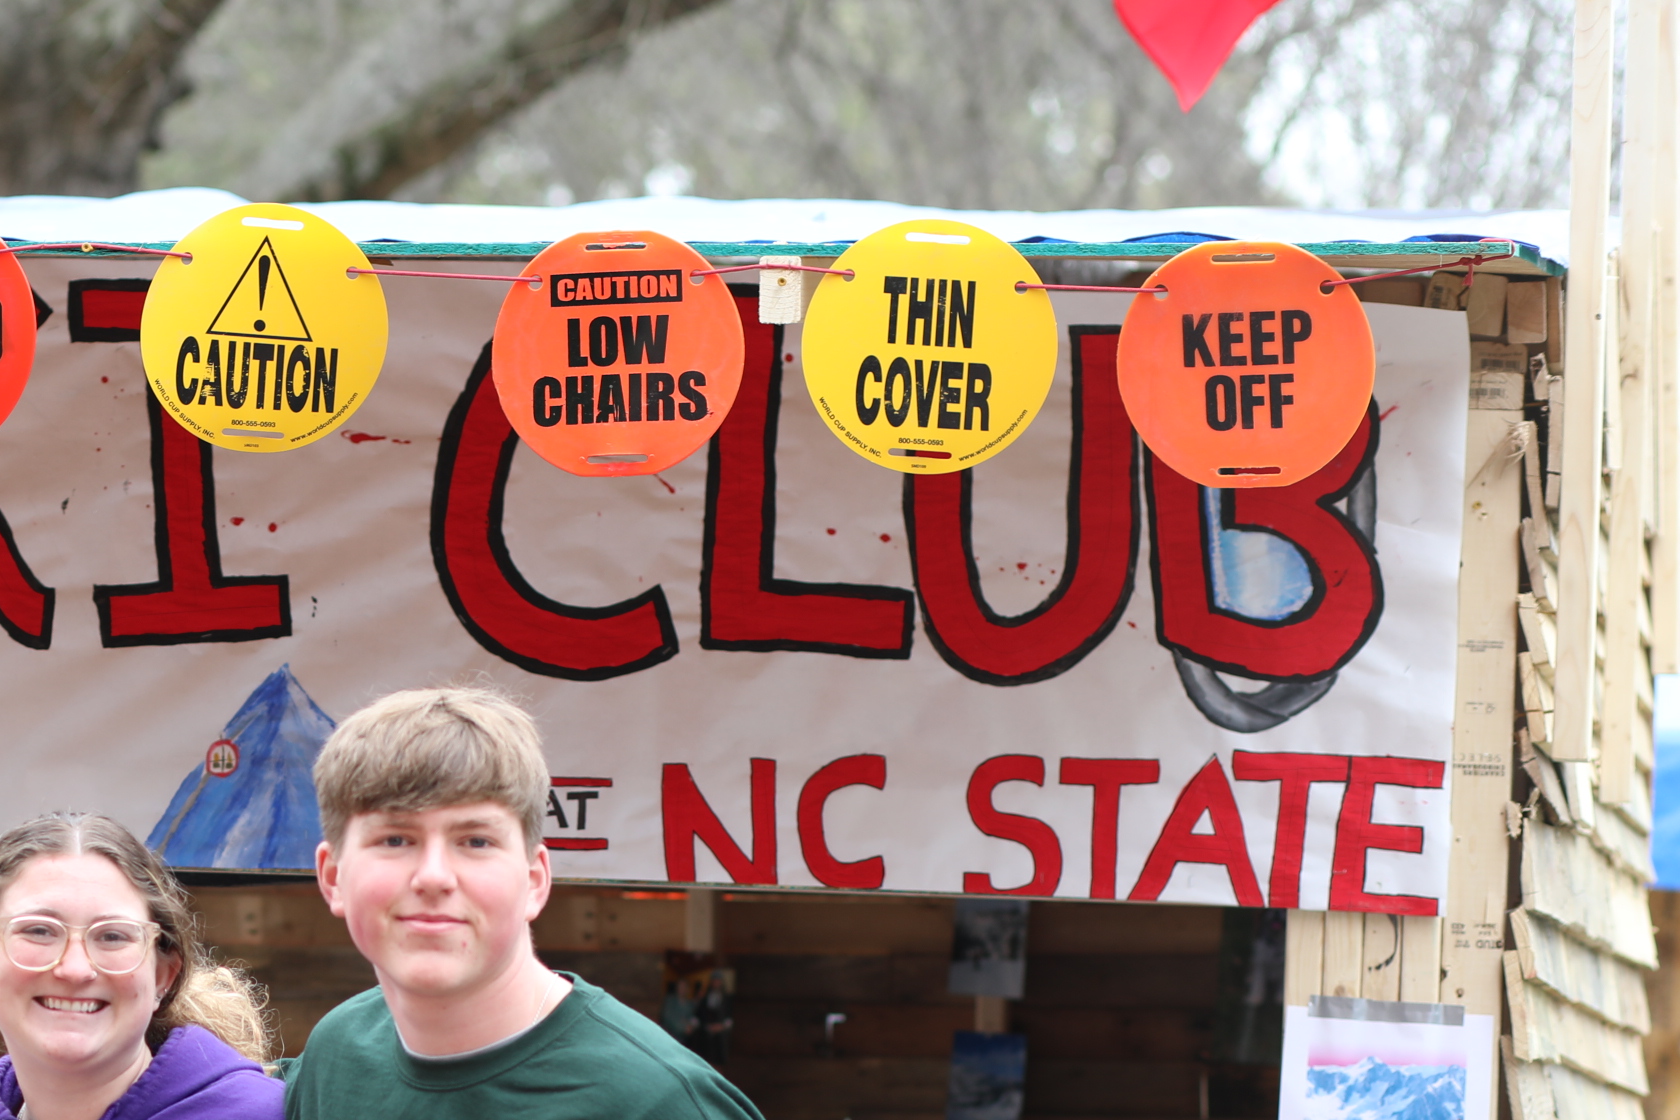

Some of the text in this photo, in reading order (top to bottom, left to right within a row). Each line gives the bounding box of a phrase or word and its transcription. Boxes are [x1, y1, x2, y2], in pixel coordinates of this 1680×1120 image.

[557, 274, 678, 302] CAUTION
[883, 275, 977, 349] THIN
[567, 314, 669, 368] LOW
[1181, 309, 1312, 368] KEEP
[176, 336, 339, 413] CAUTION
[533, 370, 709, 427] CHAIRS
[855, 354, 992, 431] COVER
[1204, 373, 1295, 431] OFF
[154, 378, 170, 403] WORLD
[168, 401, 180, 414] CUP
[201, 428, 215, 439] INC.
[231, 419, 276, 428] 800-555-0593
[290, 391, 359, 443] www.worldcupsupply.com
[819, 396, 835, 422] WORLD
[833, 419, 847, 434] CUP
[868, 447, 882, 458] INC.
[958, 409, 1028, 462] www.worldcupsupply.com
[898, 437, 944, 446] 800-555-0593
[430, 284, 1385, 686] CLUB
[545, 750, 1446, 917] AT NC STATE
